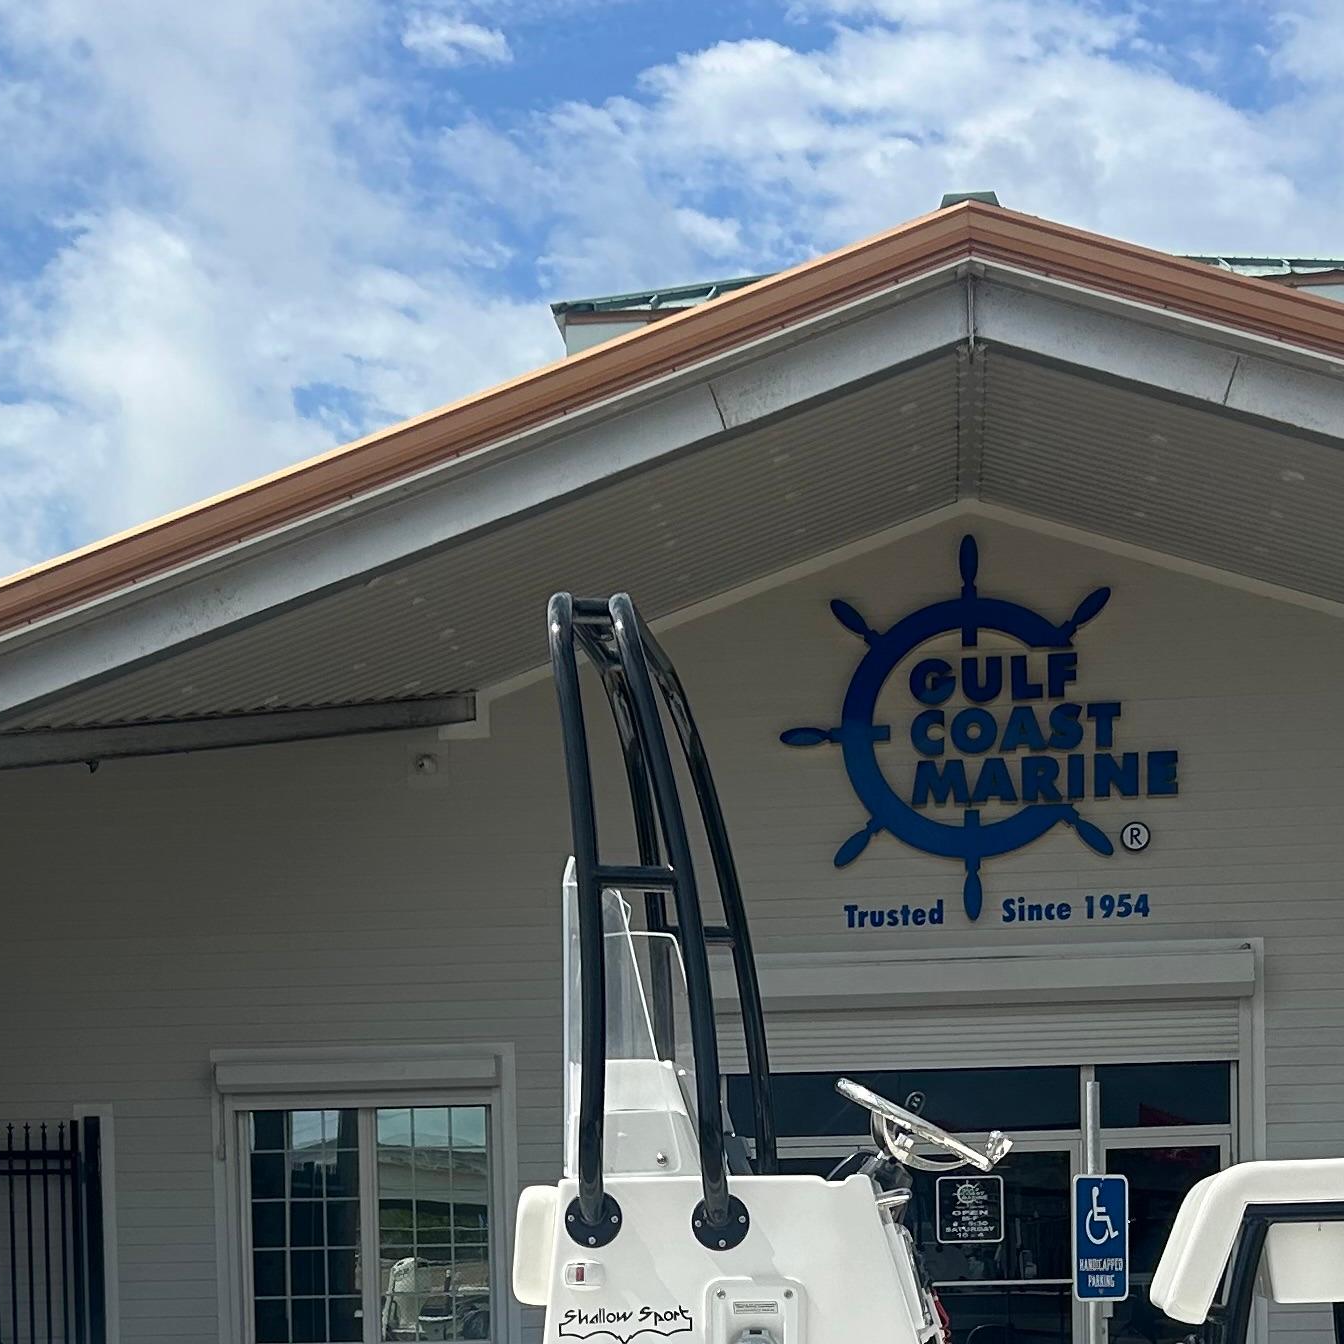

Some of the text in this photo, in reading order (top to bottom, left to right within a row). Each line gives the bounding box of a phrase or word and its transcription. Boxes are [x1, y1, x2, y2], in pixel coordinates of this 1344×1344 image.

[909, 652, 1078, 704] GULF
[910, 702, 1122, 756] COAST
[911, 750, 1179, 808] MARINE
[844, 894, 1151, 928] Trusted Since 1954
[1079, 1258, 1124, 1272] HANDICAPPED
[1088, 1274, 1115, 1288] PARKING
[562, 1304, 692, 1327] Shallow Sport
